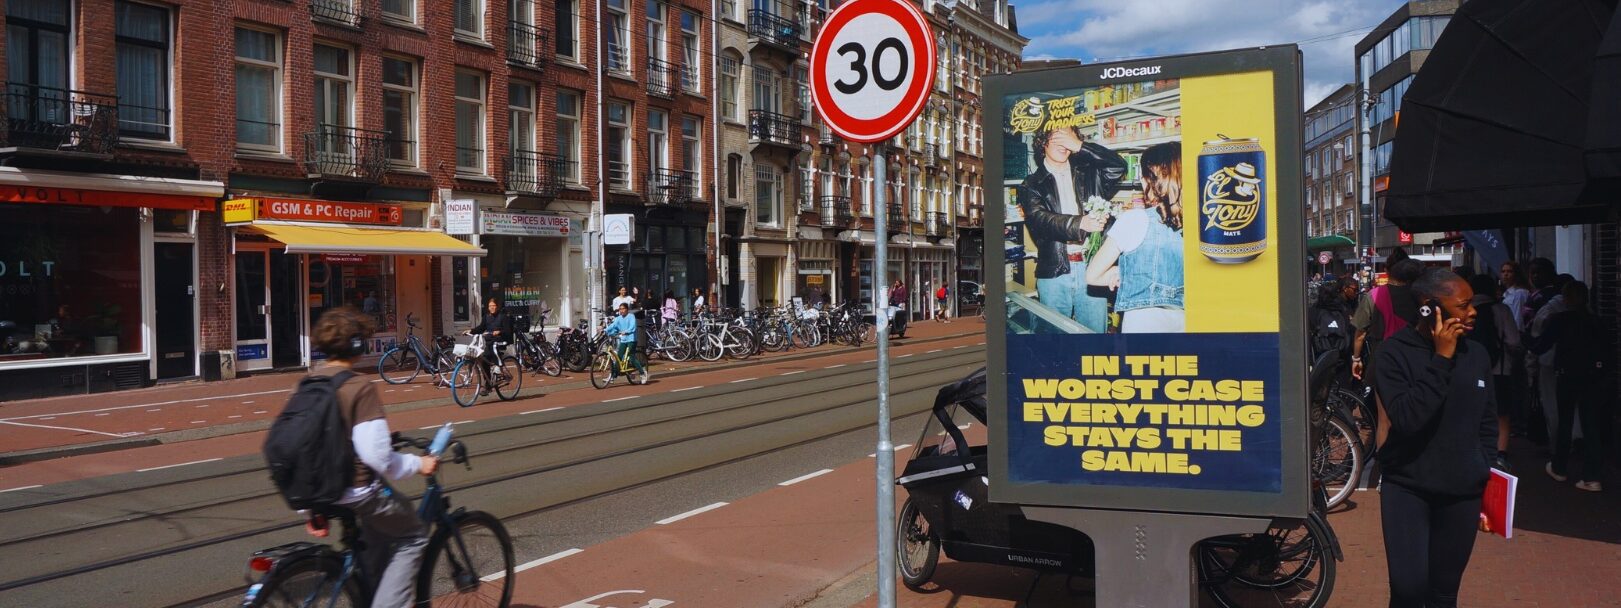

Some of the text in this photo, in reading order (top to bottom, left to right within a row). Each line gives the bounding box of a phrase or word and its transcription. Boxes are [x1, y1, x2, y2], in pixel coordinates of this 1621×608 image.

[834, 37, 908, 94] 30
[1100, 66, 1161, 79] JCDecaux
[1047, 96, 1080, 110] TRUST
[1049, 106, 1075, 120] YOUR
[1043, 114, 1095, 133] MADNESS
[17, 187, 85, 203] VOLT
[1207, 173, 1232, 199] El
[225, 203, 246, 211] DHL
[271, 202, 300, 214] GSM
[303, 203, 313, 216] &
[316, 204, 332, 217] PC
[334, 205, 373, 220] Repair
[447, 204, 472, 212] INDIAN
[1202, 199, 1258, 231] Tony
[511, 215, 538, 225] SPICES
[539, 216, 547, 225] &
[548, 217, 569, 227] VIBES
[1081, 355, 1198, 376] IN THE
[1022, 378, 1265, 401] WORST CASE
[1023, 402, 1266, 427] EVERYTHING
[1043, 425, 1242, 451] STAYS THE
[1081, 450, 1202, 475] SAME.
[1007, 554, 1062, 567] URBAN ARROW
